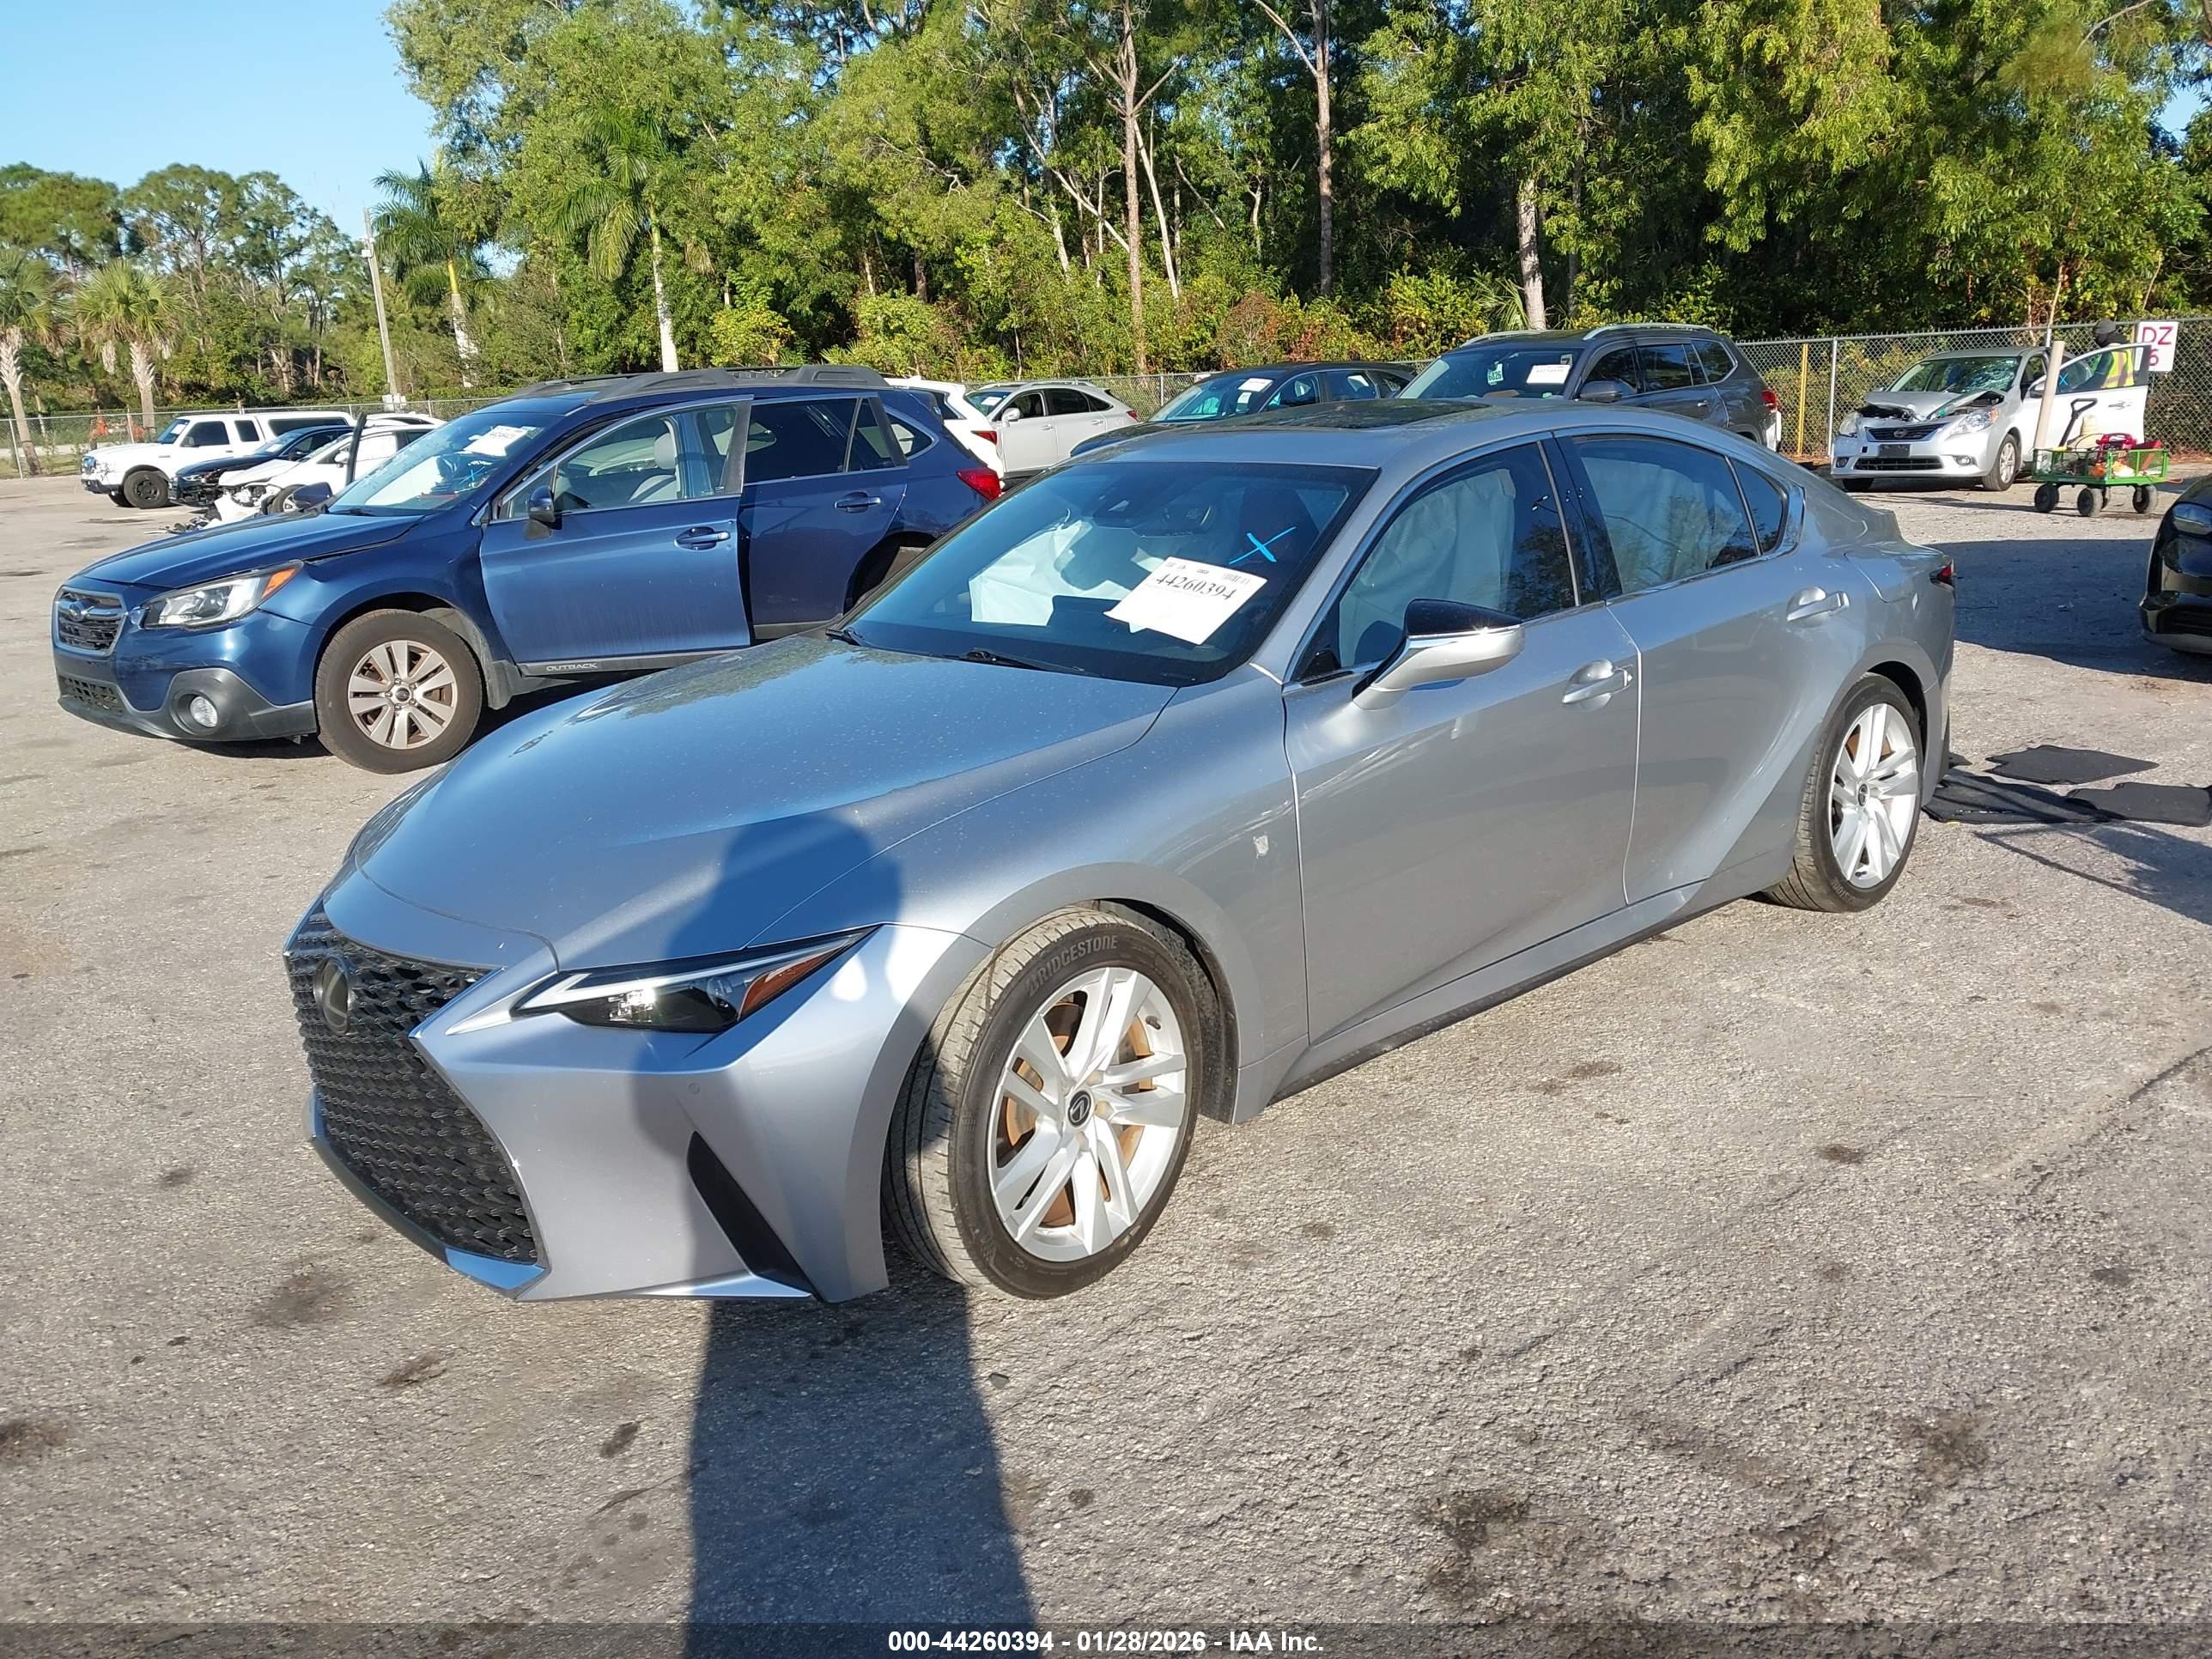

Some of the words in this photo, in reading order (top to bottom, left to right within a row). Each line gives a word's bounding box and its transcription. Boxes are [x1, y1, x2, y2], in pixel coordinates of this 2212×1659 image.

[2142, 326, 2173, 345] DZ
[1156, 573, 1237, 600] 44260394
[546, 662, 599, 672] OUTBACK
[1029, 934, 1118, 996] BRIDGESTONE
